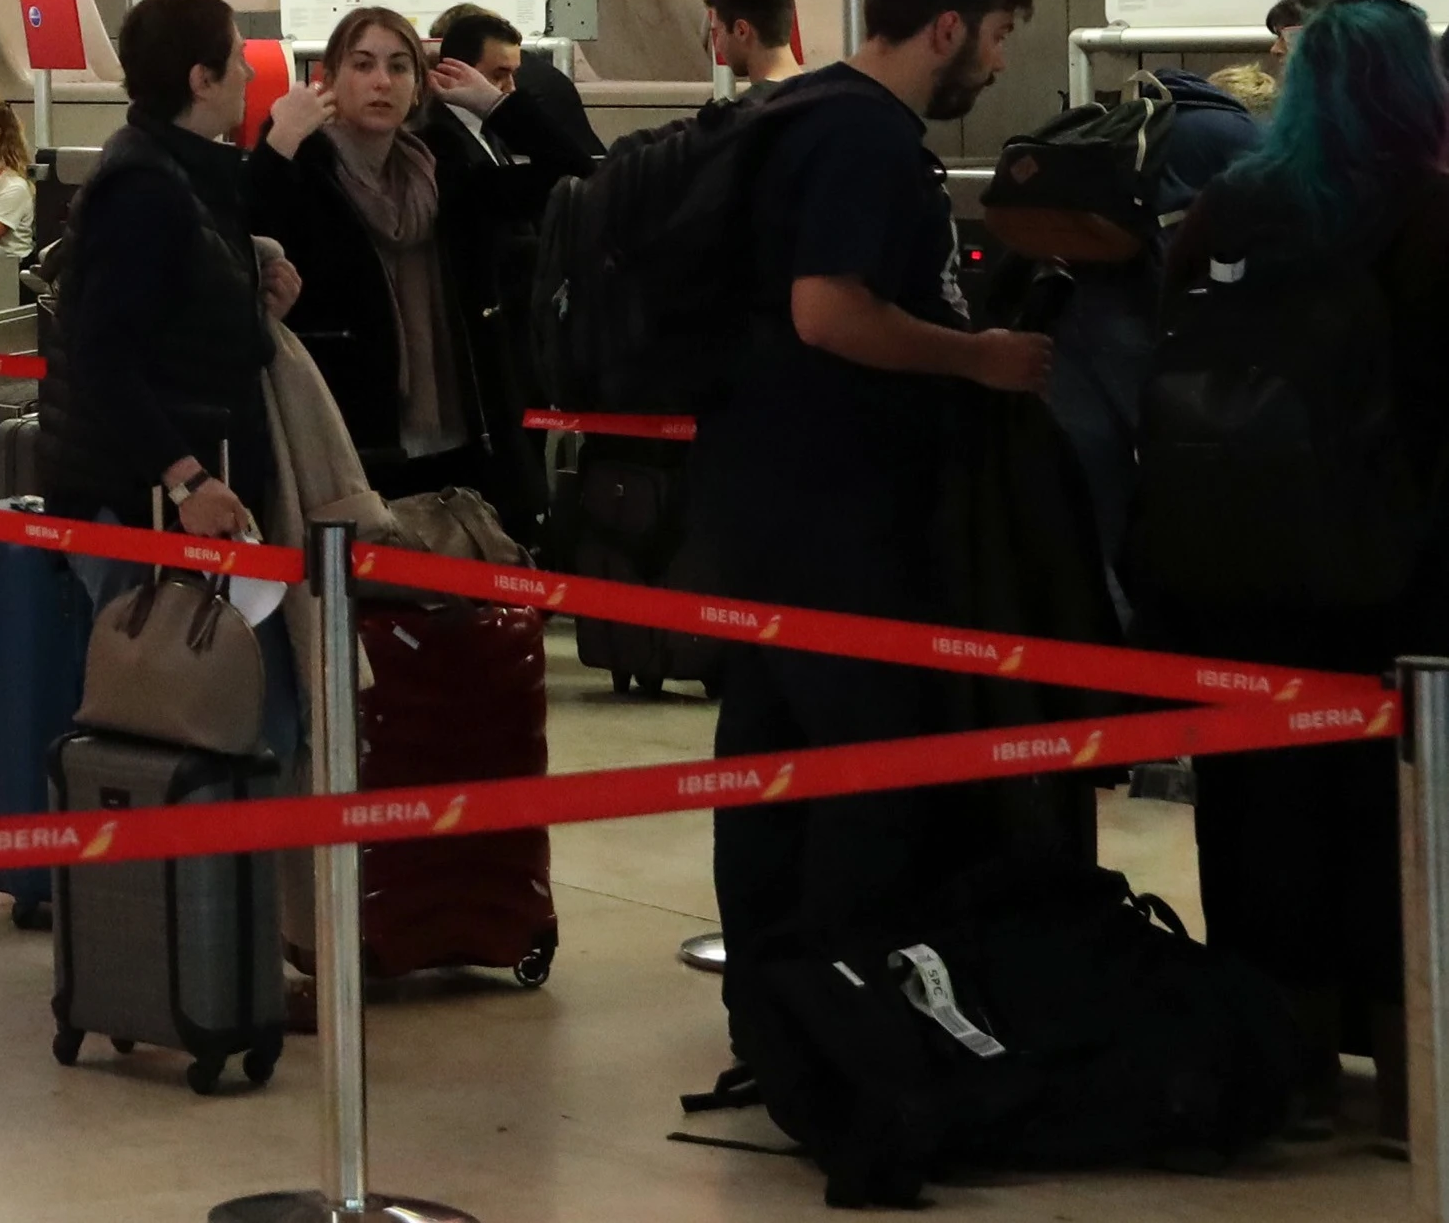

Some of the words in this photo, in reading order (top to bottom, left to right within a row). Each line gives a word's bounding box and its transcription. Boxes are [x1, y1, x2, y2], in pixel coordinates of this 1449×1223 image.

[529, 417, 565, 427] IBERIA
[24, 523, 60, 541] IBERIA
[184, 546, 222, 564] IBERIA
[494, 574, 546, 596] IBERIA
[701, 606, 758, 630] IBERIA
[932, 636, 998, 662] IBERIA
[1196, 668, 1271, 696] IBERIA
[1289, 707, 1365, 732] IBERIA
[992, 736, 1073, 763] IBERIA
[677, 768, 761, 796] IBERIA
[341, 800, 431, 826] IBERIA
